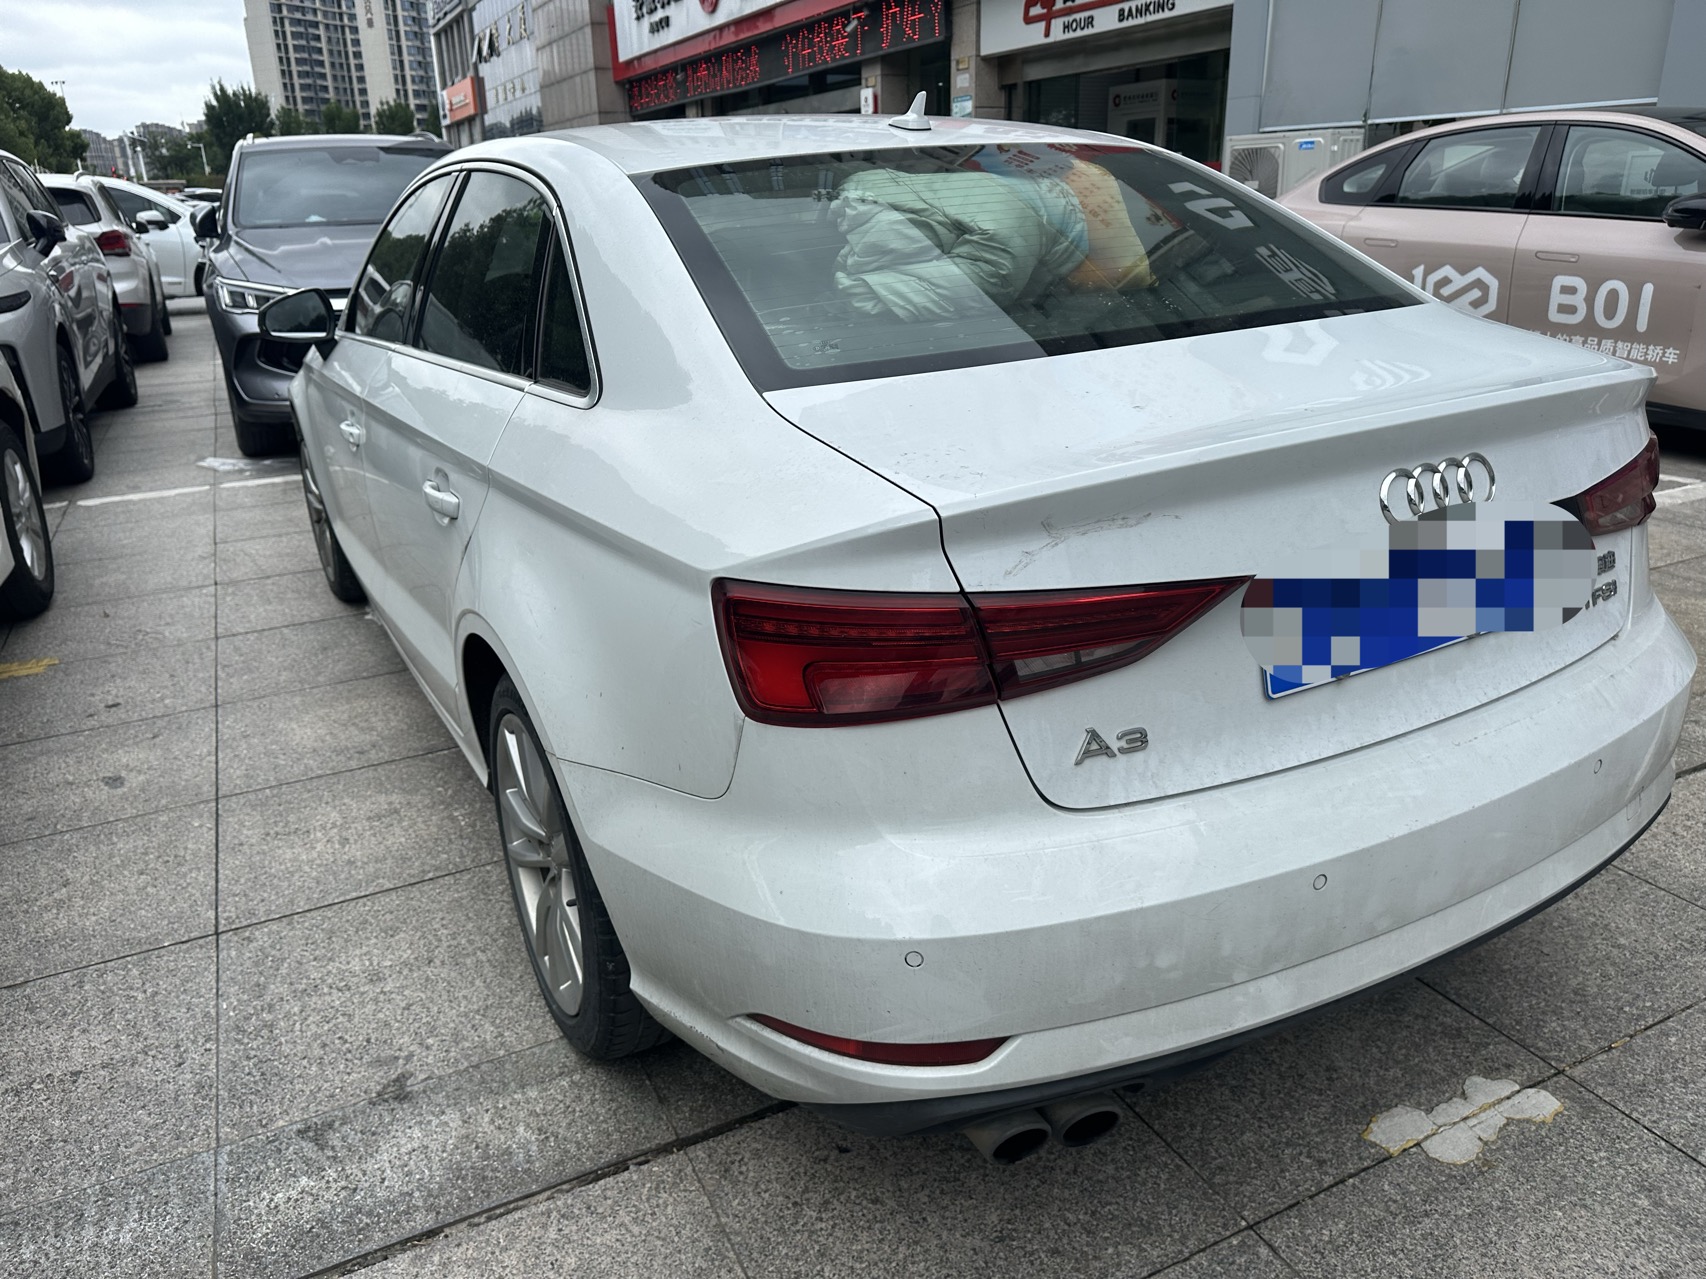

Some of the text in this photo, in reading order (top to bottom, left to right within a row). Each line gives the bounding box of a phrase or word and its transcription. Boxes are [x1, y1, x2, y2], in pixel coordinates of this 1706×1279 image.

[1062, 14, 1094, 35] HOUR
[1117, 0, 1176, 23] BANKING
[1074, 727, 1149, 766] A3
